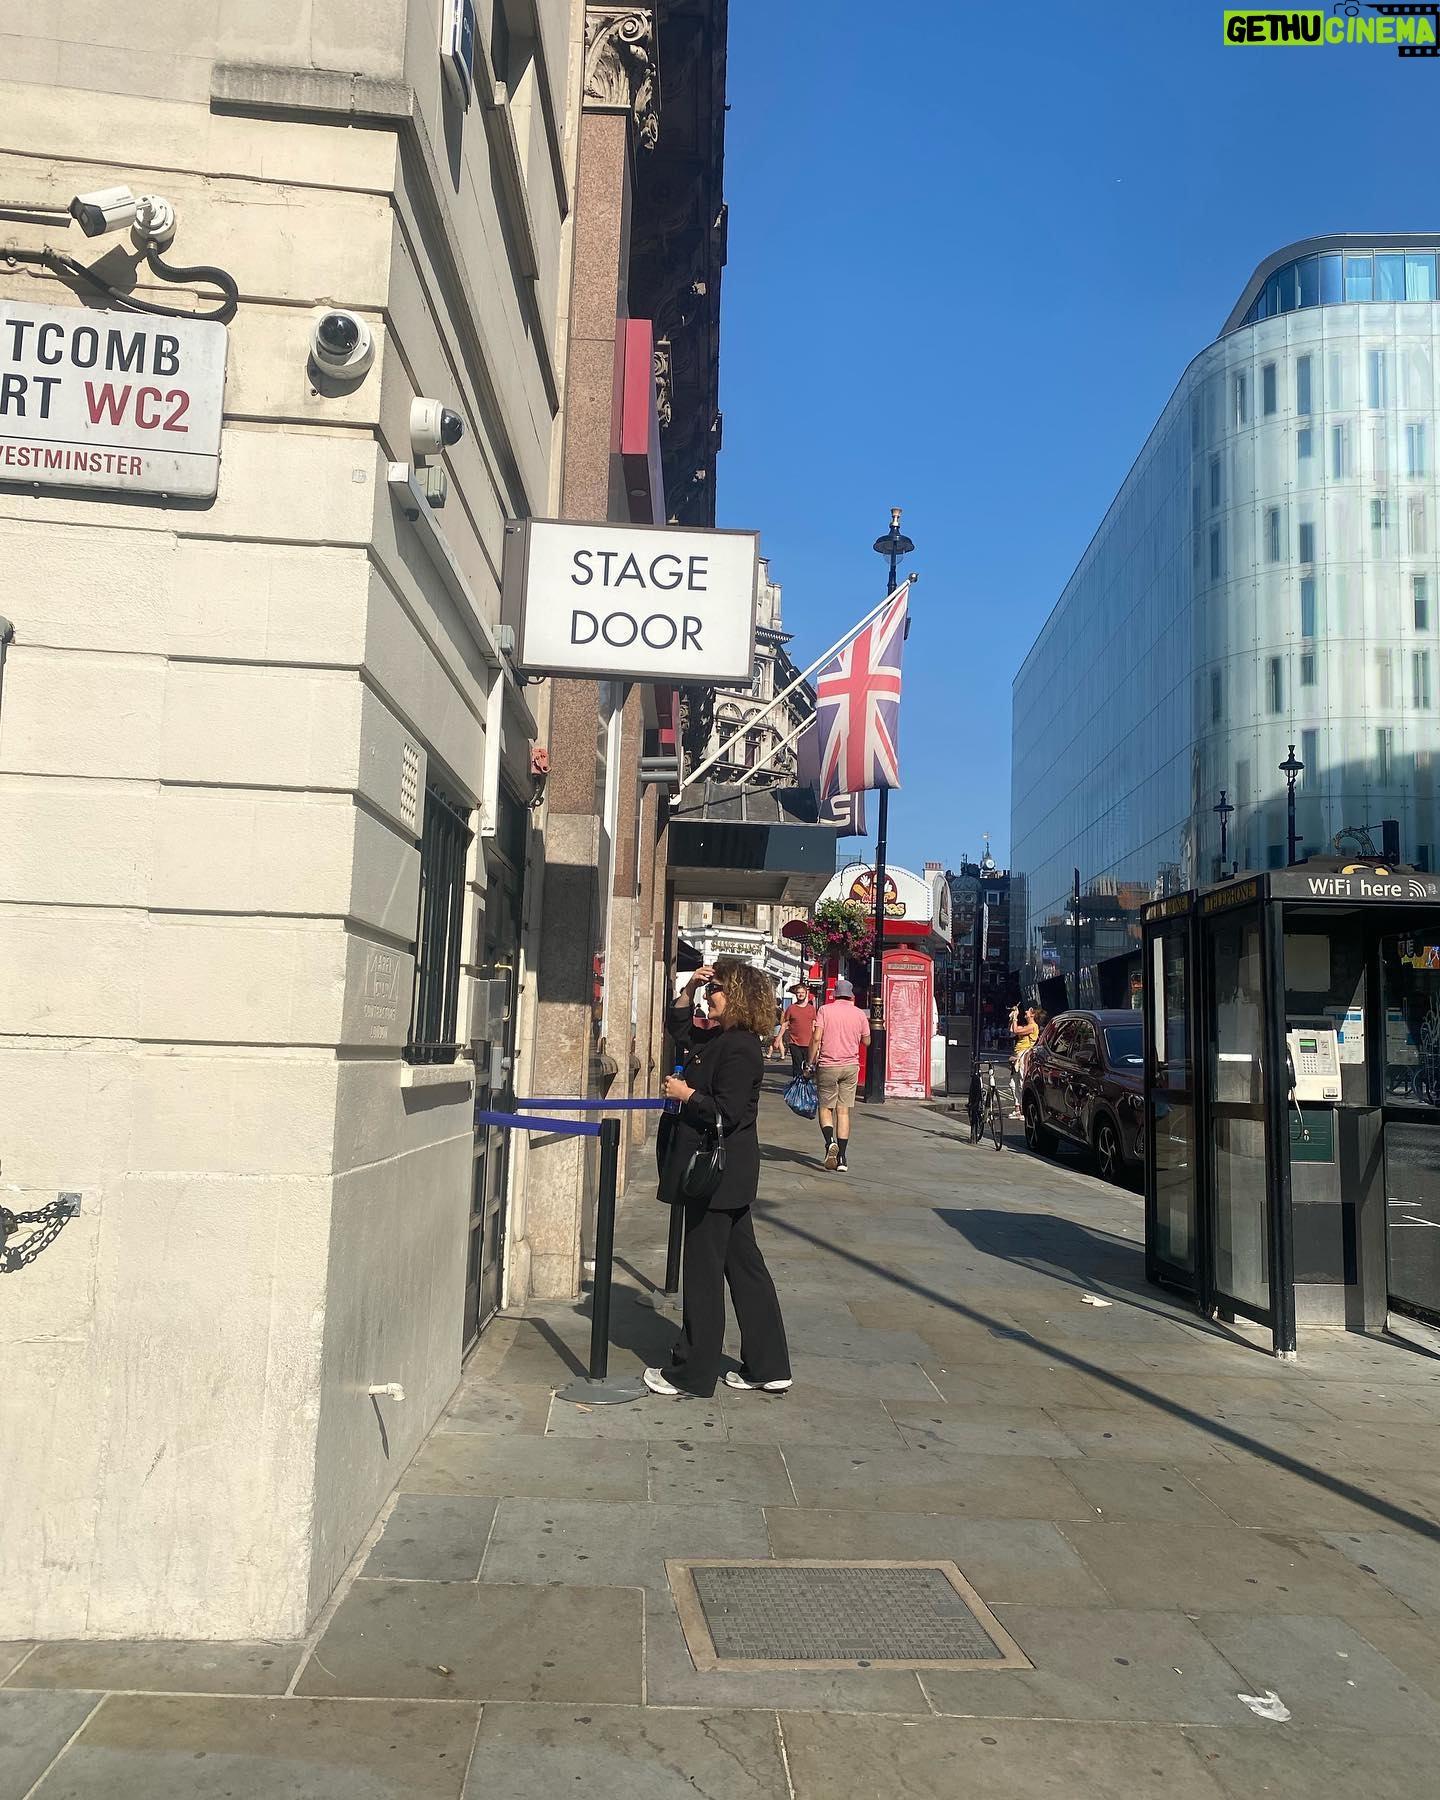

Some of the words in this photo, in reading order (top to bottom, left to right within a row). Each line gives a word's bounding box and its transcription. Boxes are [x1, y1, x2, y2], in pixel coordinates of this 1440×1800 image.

[6, 319, 180, 376] TCOMB
[0, 373, 62, 419] RT
[84, 381, 190, 433] WC2
[571, 550, 709, 591] STAGE
[571, 610, 703, 651] DOOR
[1308, 878, 1351, 896] WiFi
[1361, 879, 1402, 897] here
